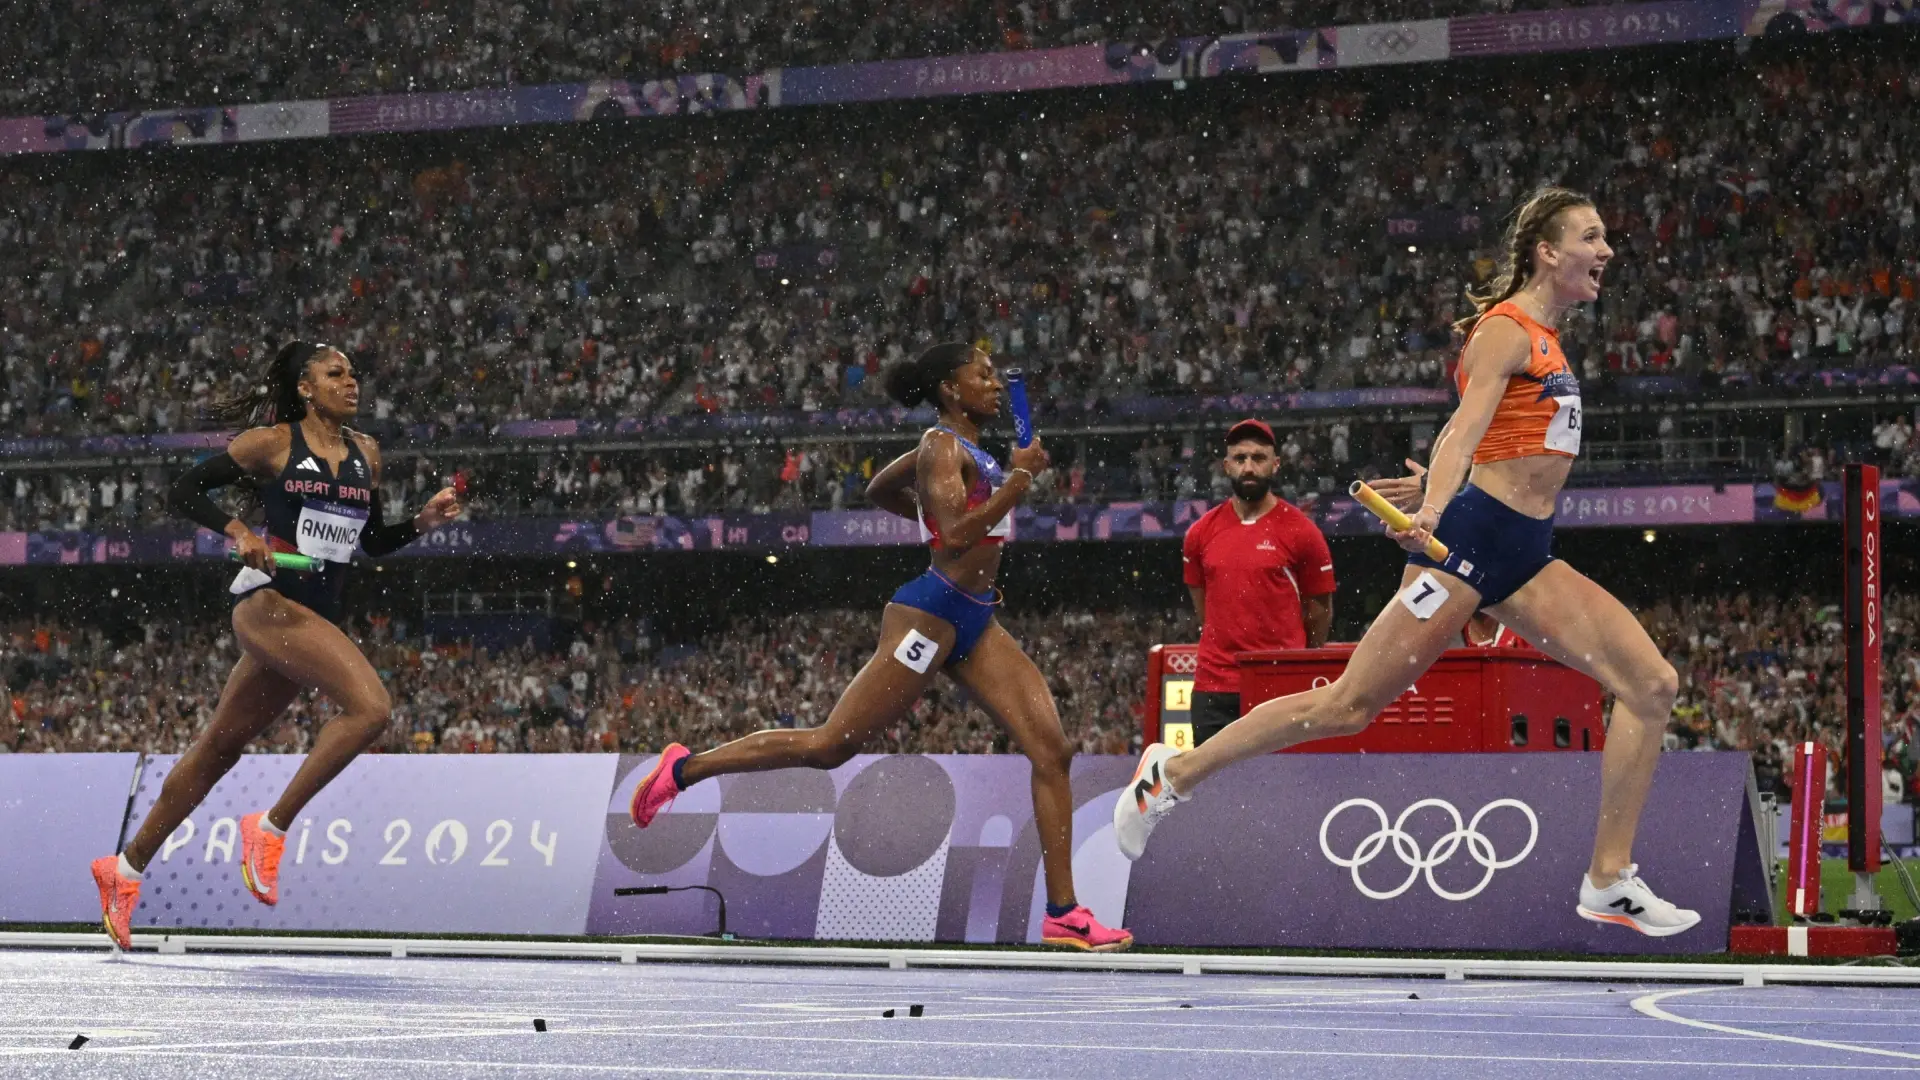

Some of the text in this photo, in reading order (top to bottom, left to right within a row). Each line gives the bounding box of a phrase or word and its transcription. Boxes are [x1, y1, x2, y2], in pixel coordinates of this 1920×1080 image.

[1508, 12, 1680, 43] PARIS 2024
[378, 102, 447, 122] PARIS
[285, 480, 330, 495] GREAT
[1562, 495, 1711, 516] PARIS 2024
[847, 518, 911, 536] PARIS
[420, 529, 472, 548] 2024
[1412, 581, 1435, 605] 7
[1866, 532, 1876, 647] OMEGA
[906, 640, 926, 662] 5
[1176, 688, 1186, 705] 1
[1175, 730, 1185, 747] 8
[162, 817, 558, 867] PAIS 2024
